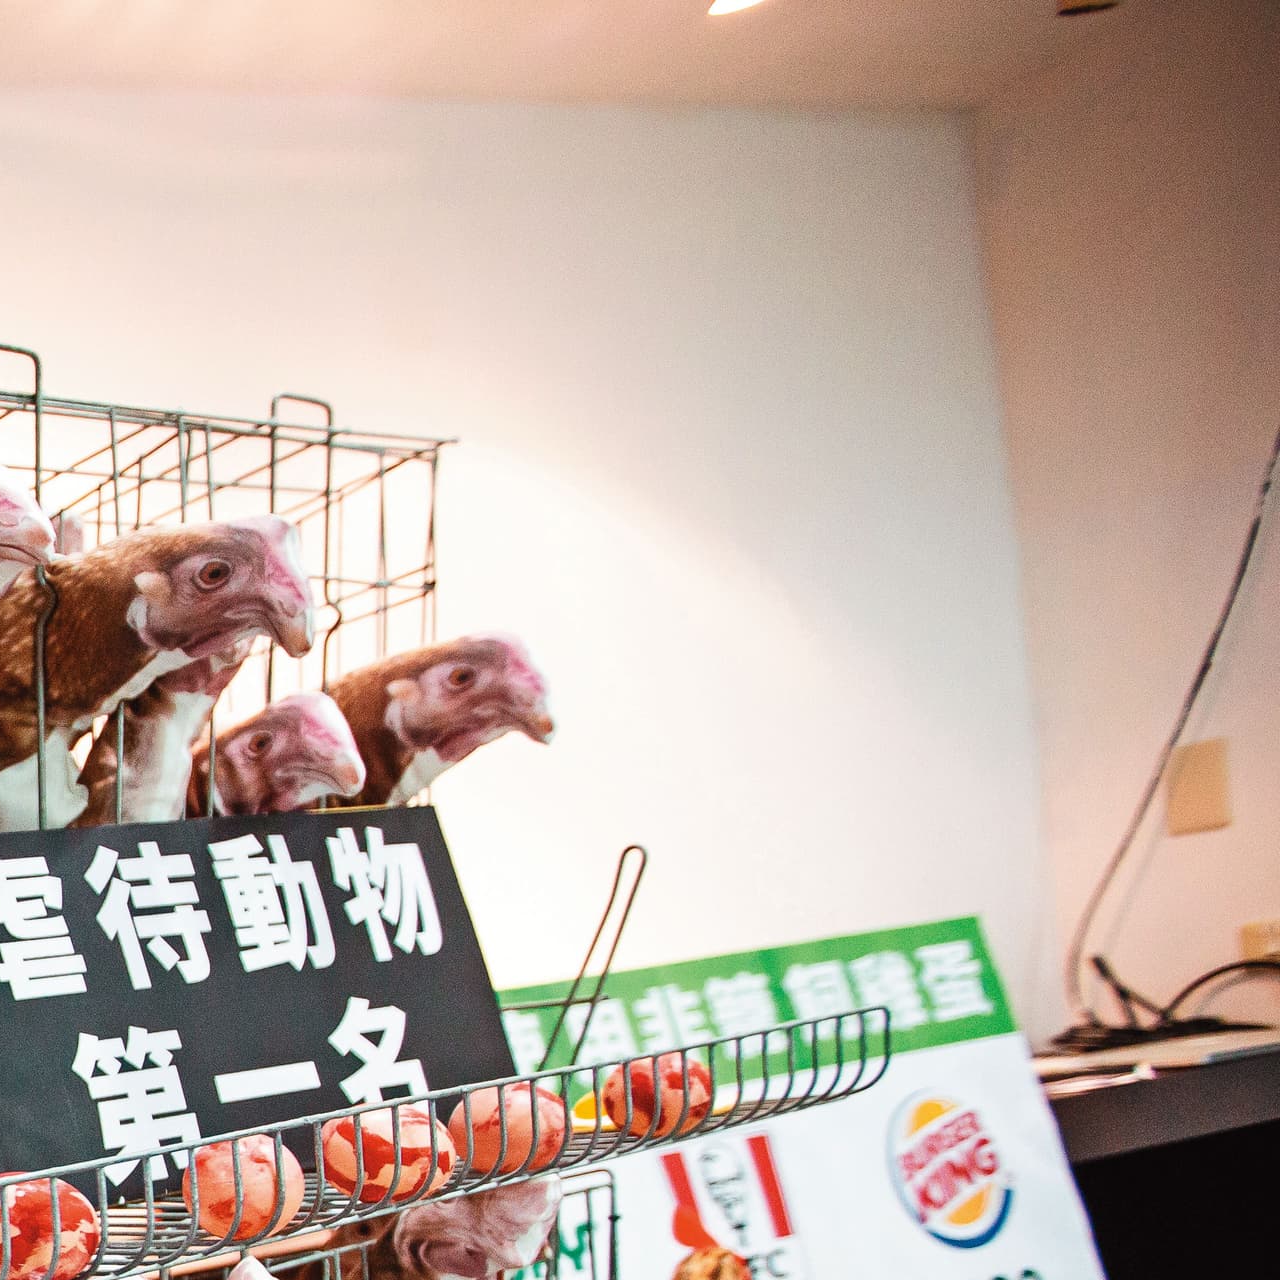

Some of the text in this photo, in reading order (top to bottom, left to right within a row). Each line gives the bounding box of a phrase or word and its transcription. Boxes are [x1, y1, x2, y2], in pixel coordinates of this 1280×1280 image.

[71, 996, 426, 1186] 第一名
[914, 1136, 1000, 1224] KING
